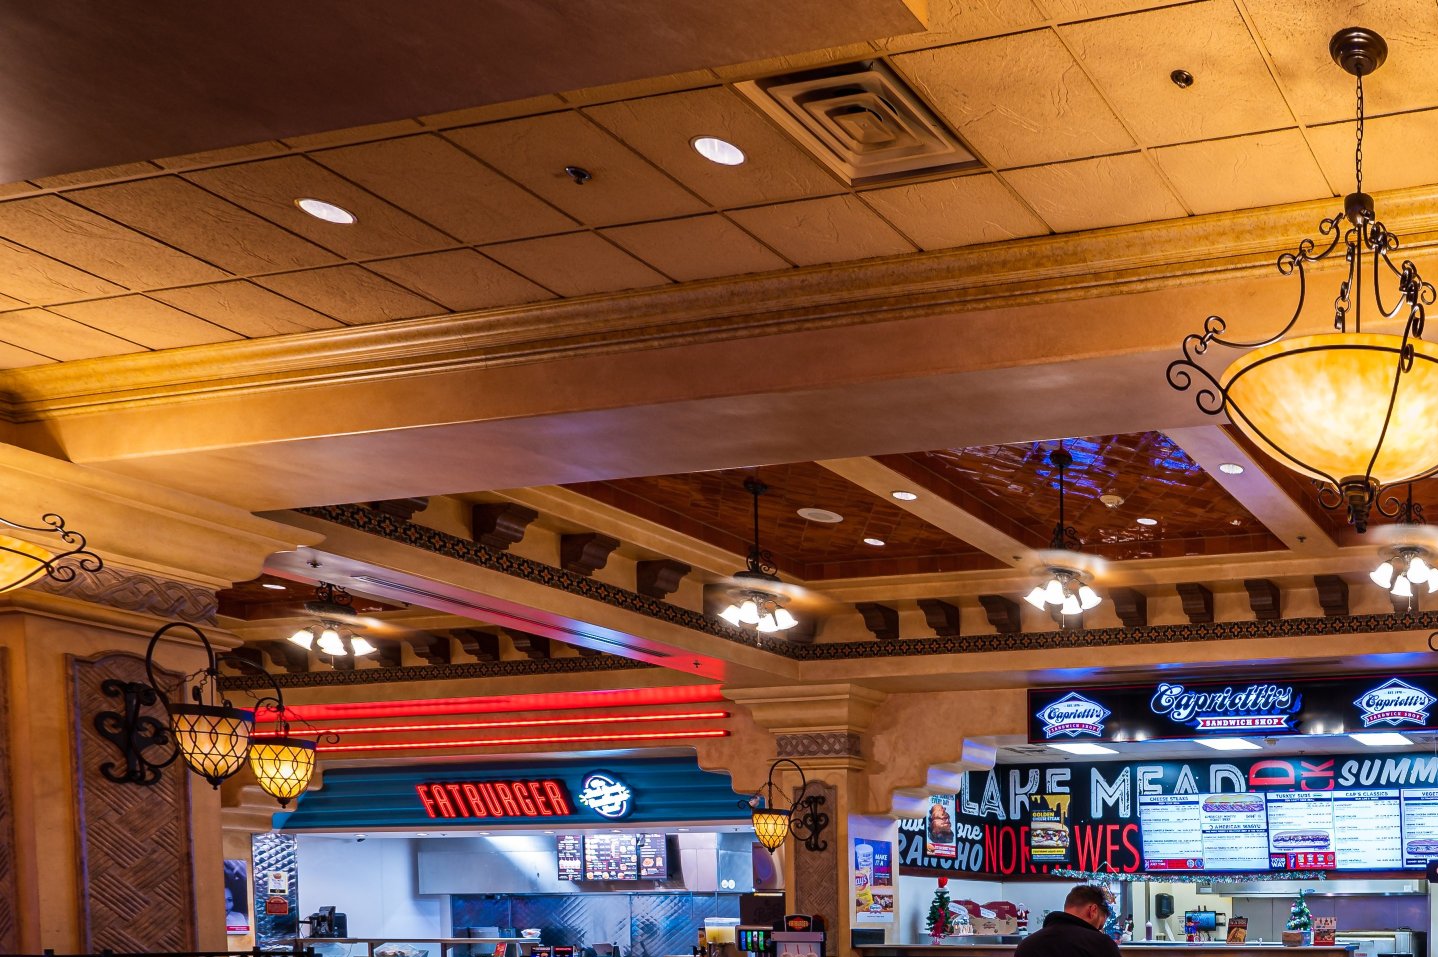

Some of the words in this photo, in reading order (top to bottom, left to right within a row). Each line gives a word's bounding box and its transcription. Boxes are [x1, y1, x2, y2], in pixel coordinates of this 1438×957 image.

[1151, 683, 1292, 721] Capriotti's
[1366, 695, 1426, 711] Capriotti's
[1047, 707, 1101, 723] Capriotti's
[1206, 719, 1253, 727] SANDWICH
[415, 779, 570, 818] FATBURGER
